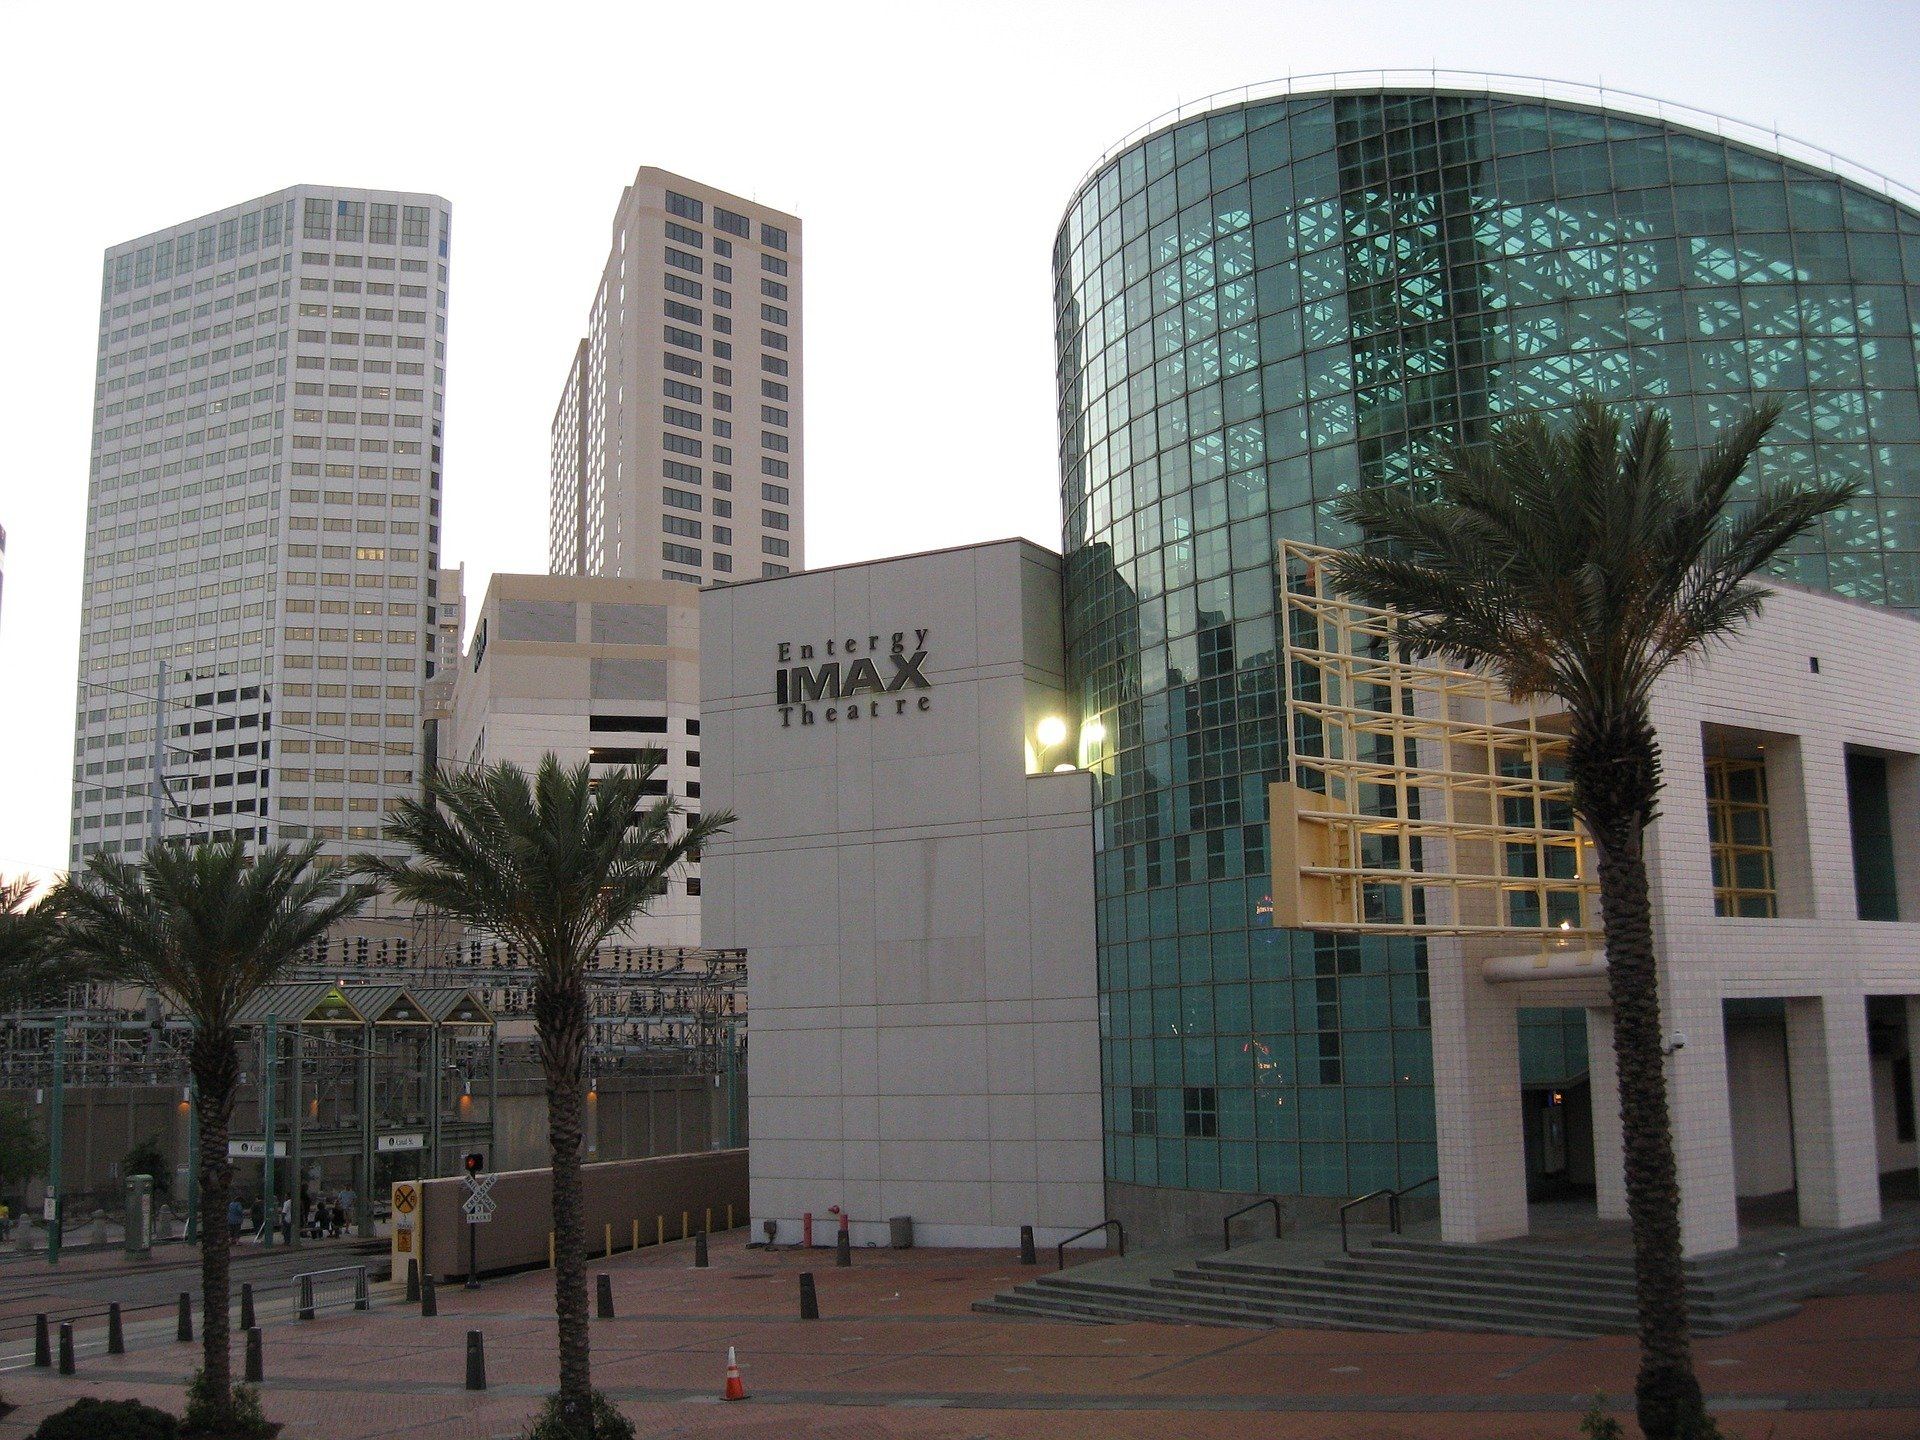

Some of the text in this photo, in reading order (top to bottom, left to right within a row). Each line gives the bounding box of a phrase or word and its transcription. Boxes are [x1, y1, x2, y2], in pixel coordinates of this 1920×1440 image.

[777, 628, 928, 662] Entergy
[776, 651, 931, 704] IMAX
[778, 696, 930, 727] Theatre
[466, 1176, 495, 1209] CROSSING
